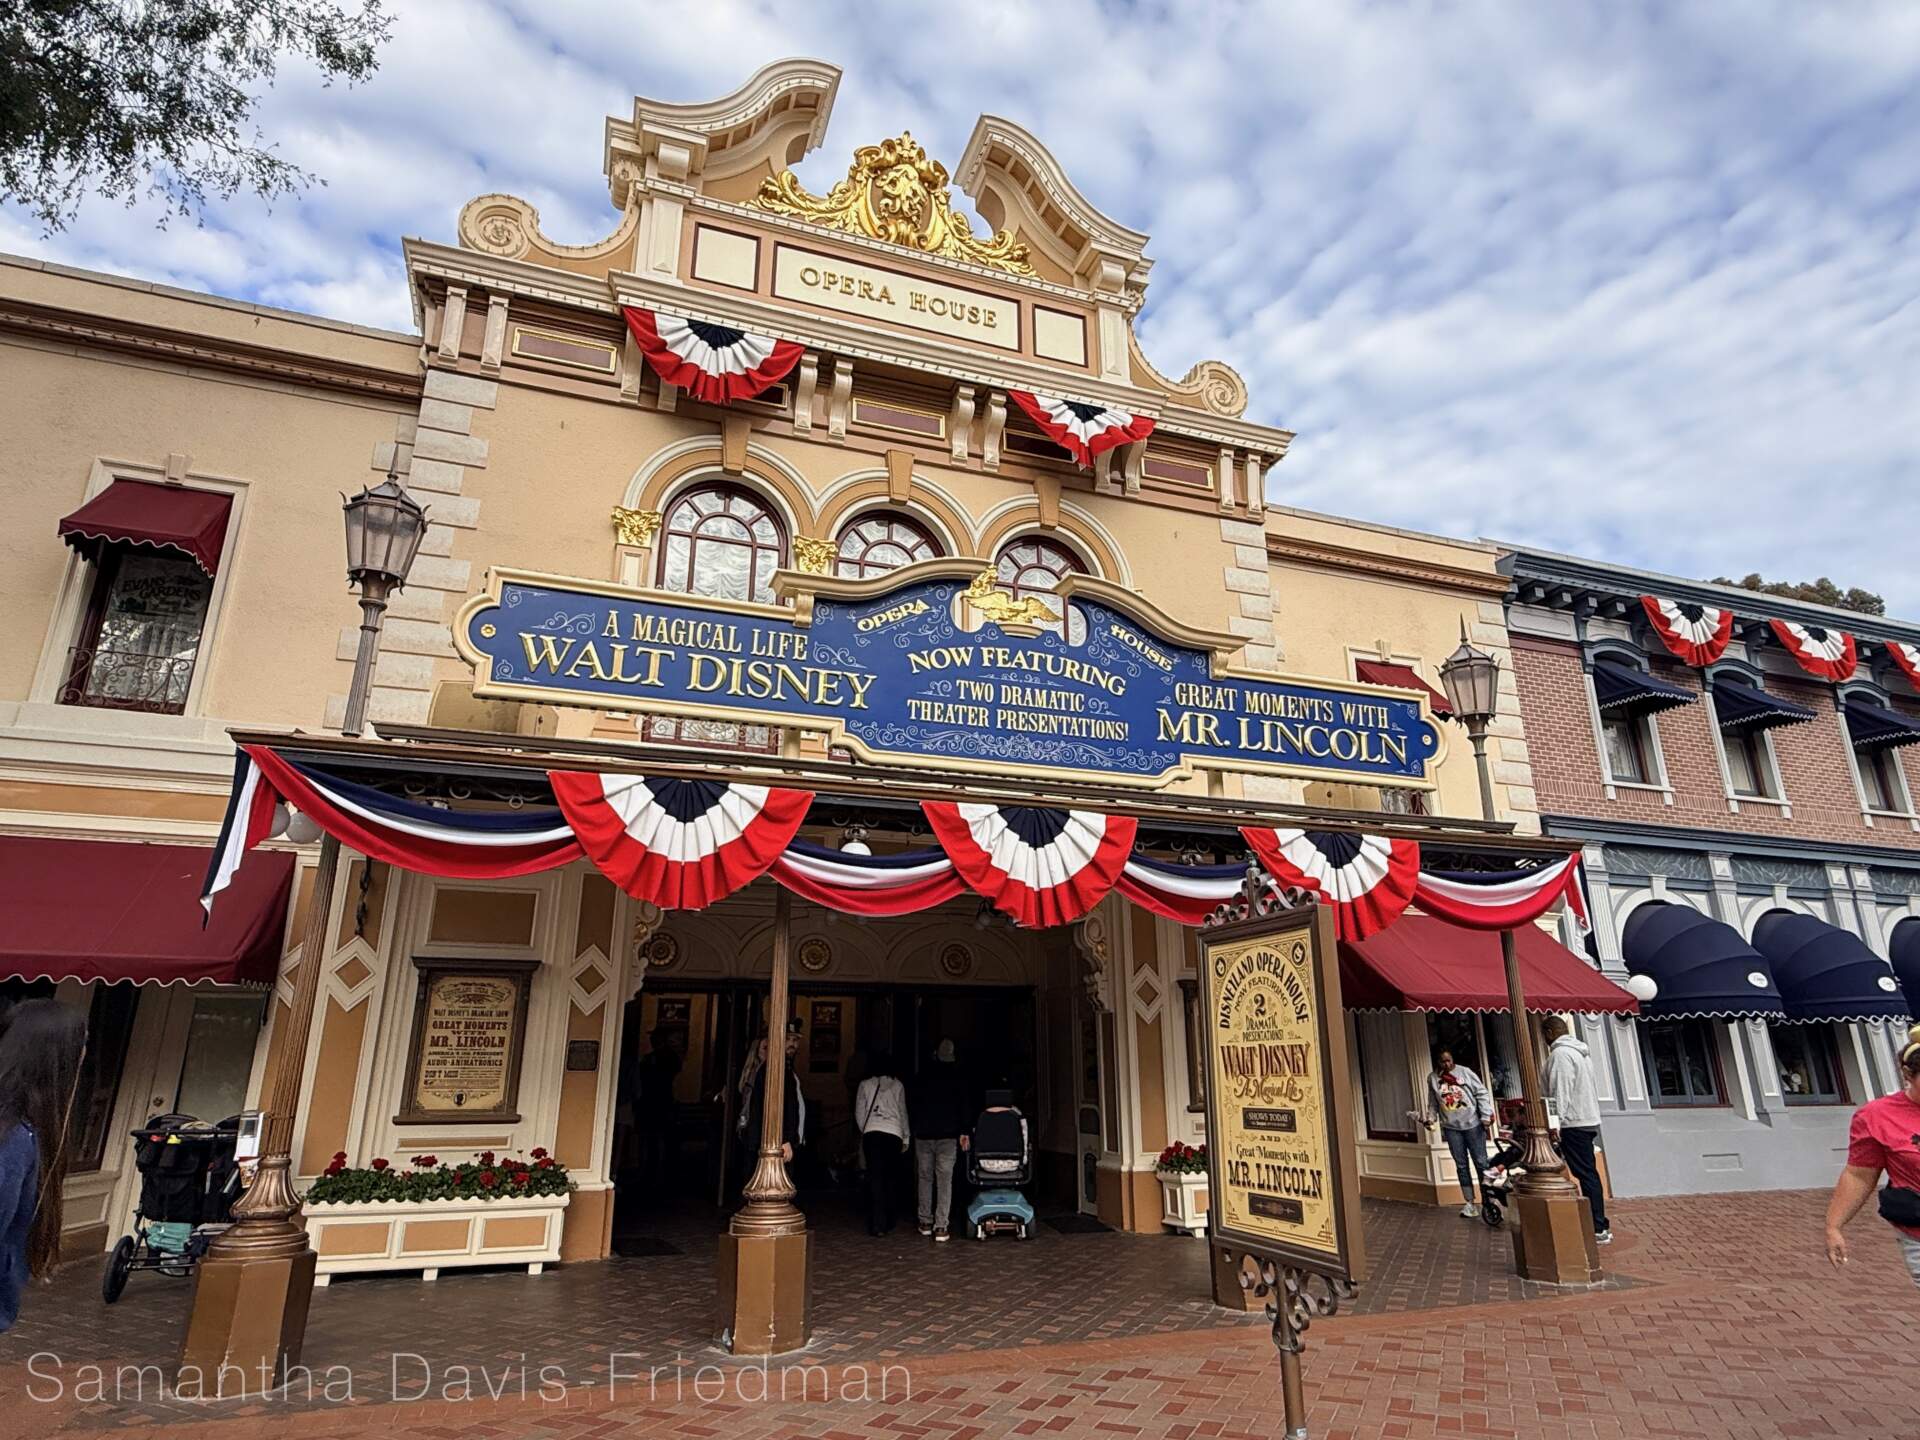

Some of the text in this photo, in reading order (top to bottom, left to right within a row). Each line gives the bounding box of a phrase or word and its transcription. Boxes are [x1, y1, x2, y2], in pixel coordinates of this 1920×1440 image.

[799, 267, 998, 328] OPERA HOUSE
[122, 577, 201, 601] EVANS GARDENS
[601, 610, 809, 661] A MAGICAL LIFE
[857, 599, 1174, 671] OPERA HOUSE
[518, 632, 878, 710] WALT DISNEY
[907, 646, 1127, 697] NOW FEATURING
[956, 679, 1086, 713] TWO DRAMATIC
[1174, 682, 1390, 730] GREAT MOMENTS WITH
[907, 699, 1130, 742] THEATER PRESENTATIONS!
[1156, 708, 1408, 765] MR. LINCOLN
[1220, 952, 1309, 1029] DISNEYLAND OPERA HOUSE
[1234, 976, 1289, 1012] NOW FEATURING
[1253, 993, 1267, 1017] 2
[430, 1035, 506, 1048] MR. LINCOLN
[432, 1020, 508, 1030] GREAT MOMENTS
[1245, 1012, 1279, 1031] DRAMATIC
[1220, 1042, 1311, 1080] WALT DISNEY
[1236, 1143, 1309, 1165] Great Moments with
[1228, 1160, 1322, 1200] MR. LINCOLN
